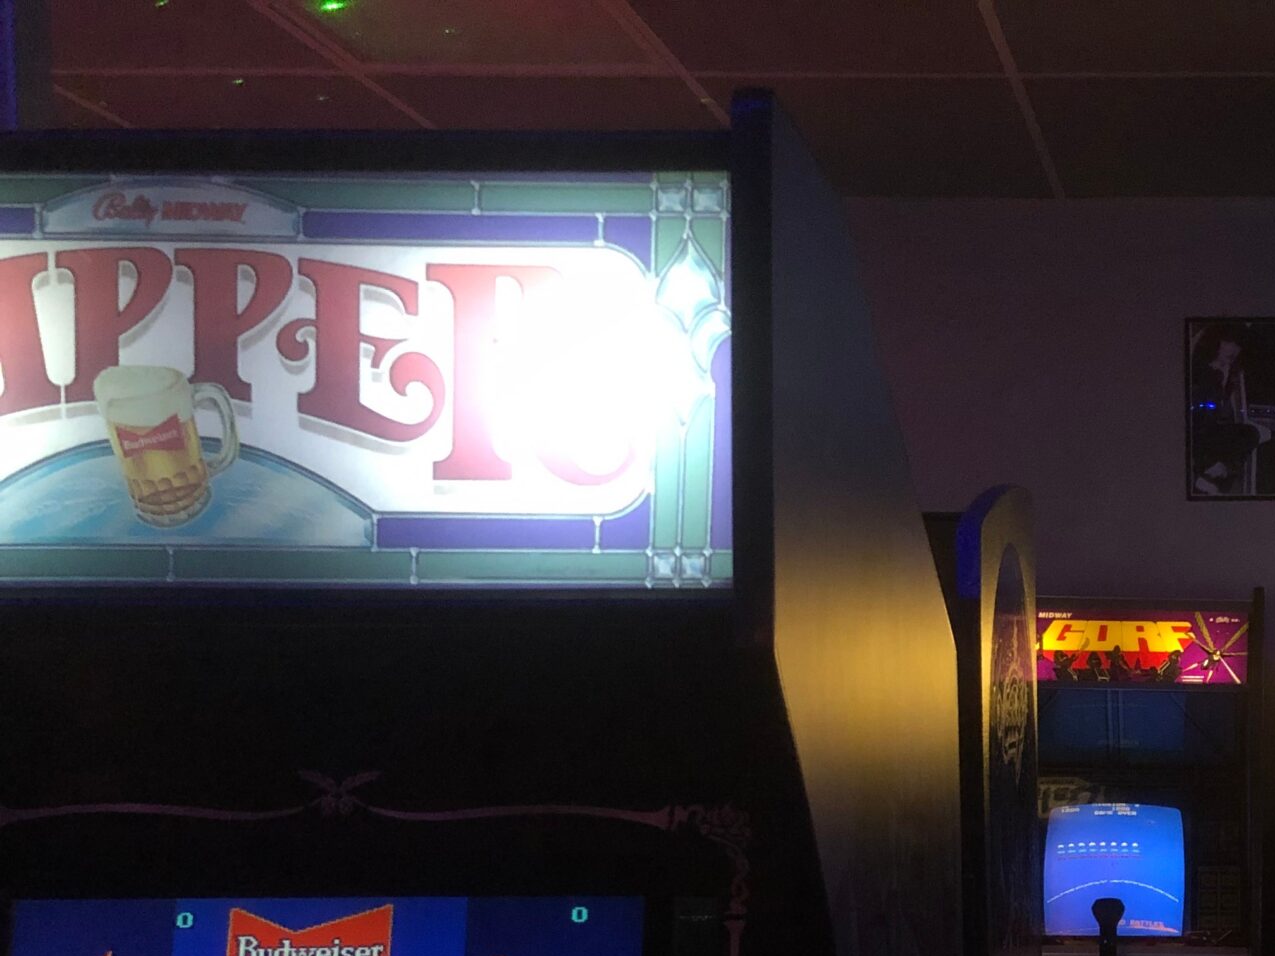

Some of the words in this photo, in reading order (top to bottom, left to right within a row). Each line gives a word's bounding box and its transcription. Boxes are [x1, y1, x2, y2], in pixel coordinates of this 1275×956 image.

[1038, 611, 1073, 619] MIDWAY
[1042, 620, 1195, 654] GORF
[176, 912, 194, 928] 0
[571, 906, 588, 923] 0
